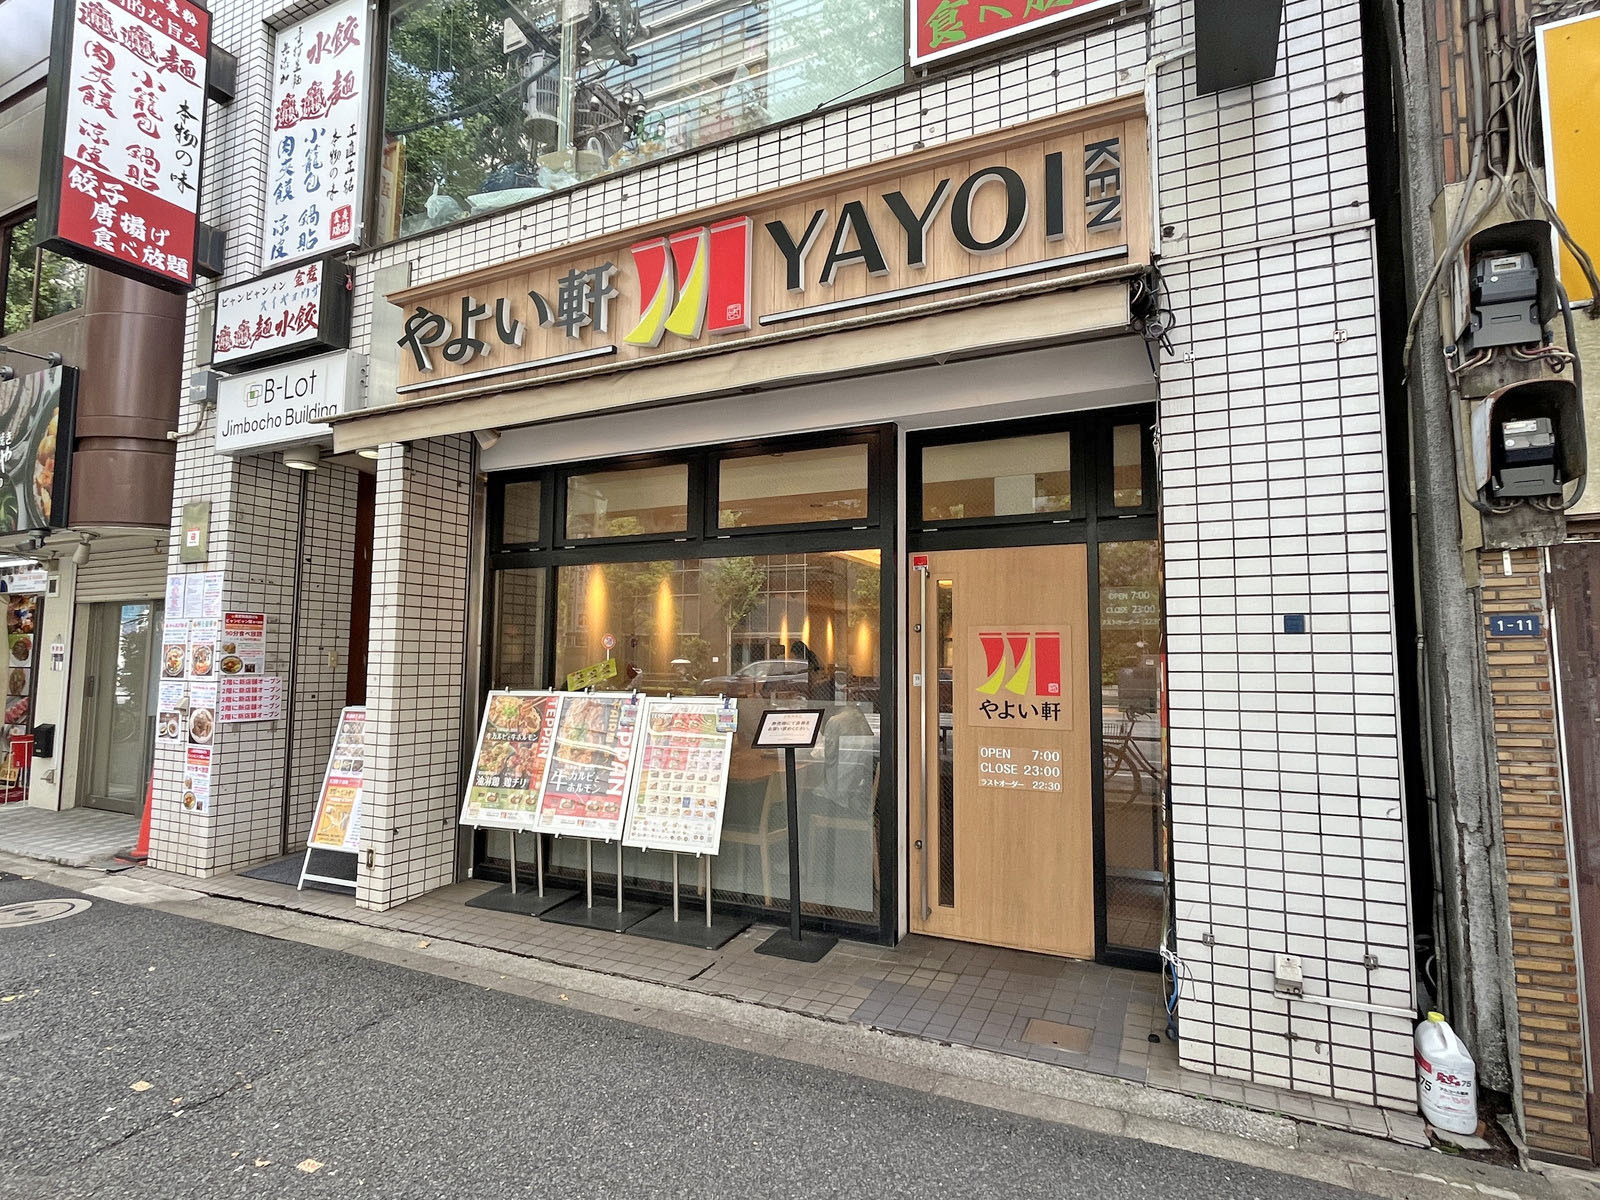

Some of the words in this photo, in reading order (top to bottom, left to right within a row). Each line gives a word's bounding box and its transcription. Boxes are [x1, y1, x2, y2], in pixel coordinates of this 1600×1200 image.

[306, 15, 361, 65] 水餃
[170, 100, 199, 194] 本物の味
[68, 165, 128, 206] 餃子
[1085, 137, 1123, 234] KEN
[90, 200, 170, 247] 唐揚げ
[765, 150, 1066, 294] YAYOI
[92, 226, 189, 279] 食べ放題
[396, 261, 620, 374] やよい軒
[264, 369, 317, 404] B-Lot
[222, 412, 282, 438] Jimbocho
[1131, 591, 1150, 600] 7:00
[1131, 605, 1156, 614] 23:00
[1496, 619, 1533, 632] 1-11
[537, 697, 558, 758] TEPPAN
[979, 699, 1061, 721] やよい軒
[980, 747, 1011, 759] OPEN
[1031, 750, 1060, 762] 7:00
[980, 762, 1018, 775] CLOSE
[1023, 764, 1060, 778] 23:00
[980, 778, 1024, 788] ラストオーダー
[1032, 780, 1061, 791] 22:30
